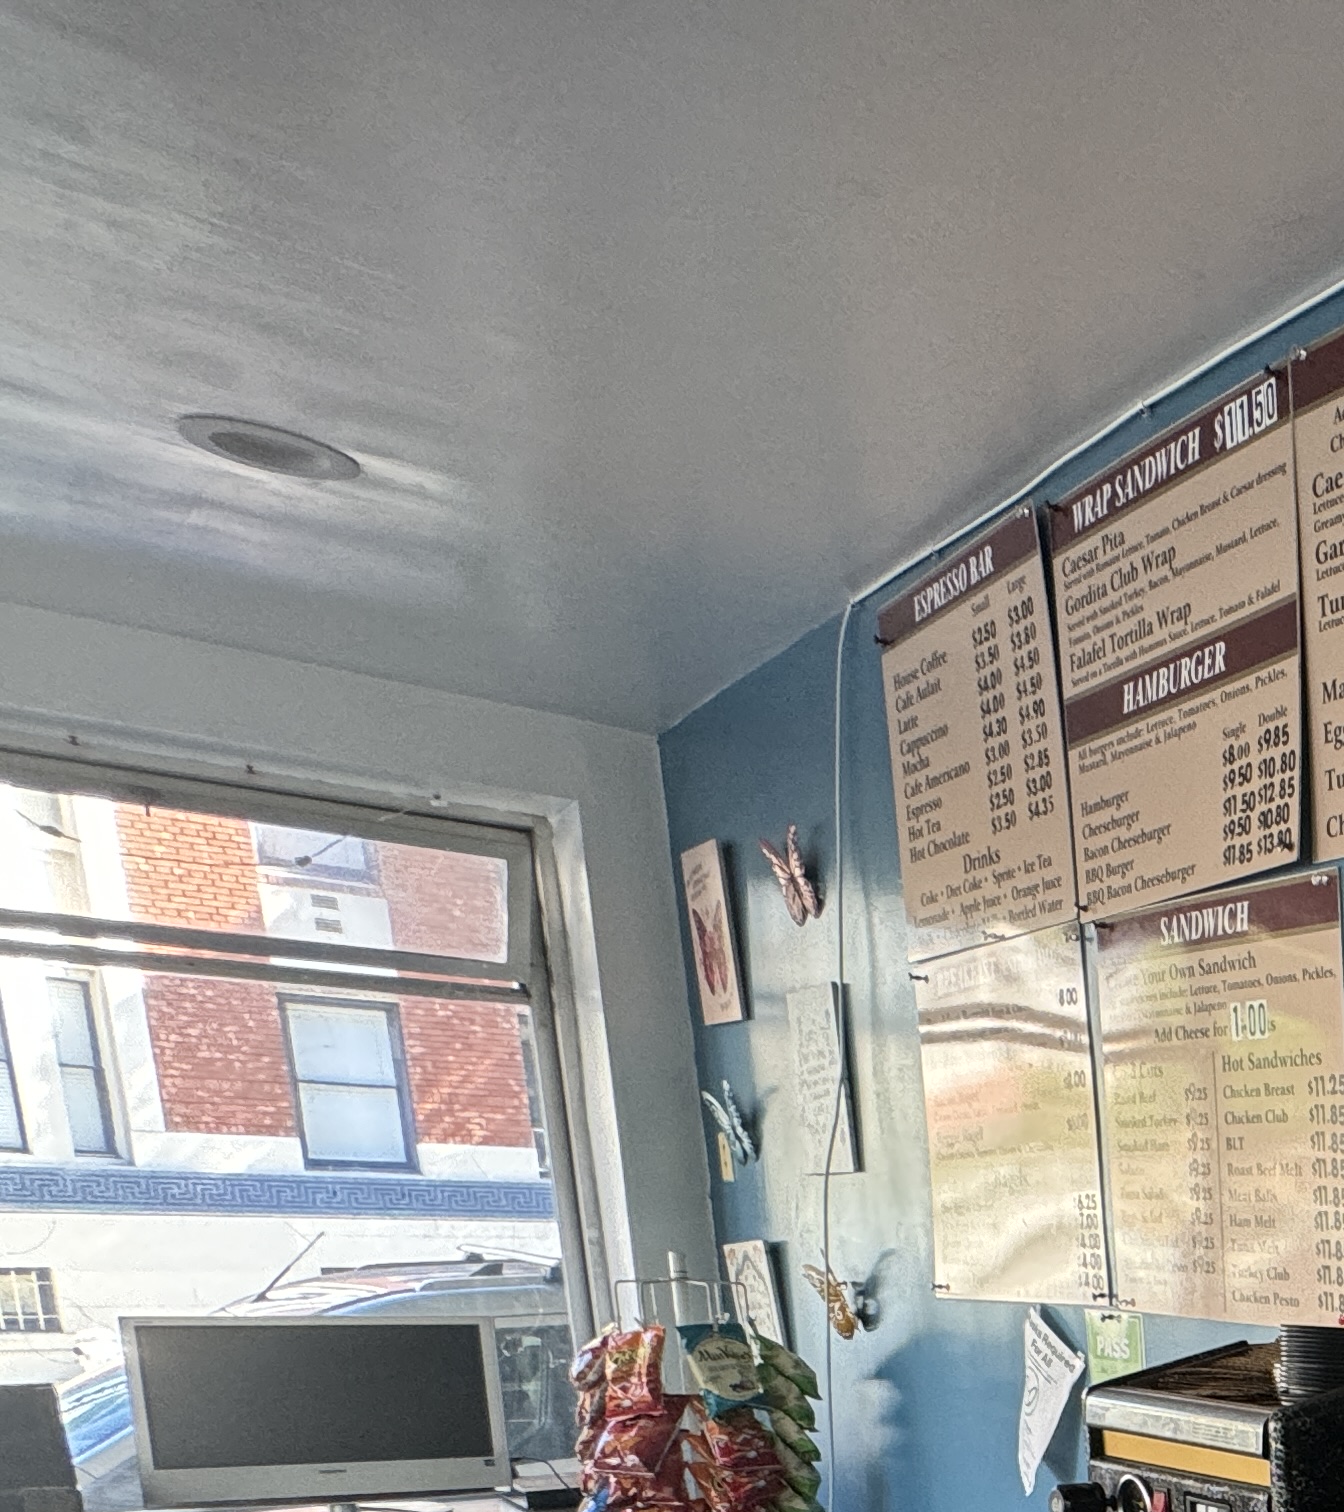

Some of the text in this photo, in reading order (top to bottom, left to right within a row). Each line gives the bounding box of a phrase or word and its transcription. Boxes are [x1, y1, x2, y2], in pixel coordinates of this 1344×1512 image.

[1072, 379, 1277, 531] WRAP SANDWICH $11.50
[1061, 546, 1098, 577] Caesar
[1101, 531, 1125, 555] Pita
[914, 545, 993, 620] ESPRESSO BAR
[1065, 583, 1107, 615] Gordita
[1109, 561, 1138, 591] Club
[1140, 546, 1176, 573] Wrap
[1069, 638, 1106, 672] Falafel
[1109, 618, 1153, 652] Tortilla
[1155, 602, 1191, 629] Wrap
[919, 650, 947, 675] Coffee
[1123, 642, 1224, 712] HAMBURGER
[1258, 704, 1287, 726] Double
[924, 761, 970, 790] Americano
[1080, 723, 1289, 817] Hamburger $8.00 $9.85
[1081, 749, 1296, 839] Cheeseburger $9.50 $10.80
[906, 797, 942, 822] Espresso
[1083, 844, 1109, 862] Bacon
[1110, 823, 1170, 852] Cheeseburger
[1257, 776, 1294, 804] $12.85
[907, 818, 941, 842] Hot Tea
[927, 831, 969, 856] Chocolate
[962, 845, 1000, 873] Drinks
[1085, 859, 1134, 884] BBQ Burger
[1106, 864, 1195, 900] Bacon Cheeseburger
[1160, 901, 1250, 948] SANDWICH
[1169, 950, 1256, 979] Own Sandwich
[1189, 966, 1335, 996] Lettuce, Onions, Pickles,
[1174, 1025, 1209, 1040] Cheese
[1212, 1021, 1227, 1037] for
[1221, 1048, 1321, 1072] Hot Sandwiches
[1222, 1084, 1260, 1099] Chicken
[1263, 1082, 1294, 1096] Breast
[1223, 1110, 1262, 1125] Chicken
[1264, 1108, 1288, 1123] Club
[1225, 1136, 1244, 1150] BLT
[1272, 1291, 1299, 1307] Pesto
[1041, 1333, 1076, 1374] Required
[1096, 1334, 1130, 1360] PASS
